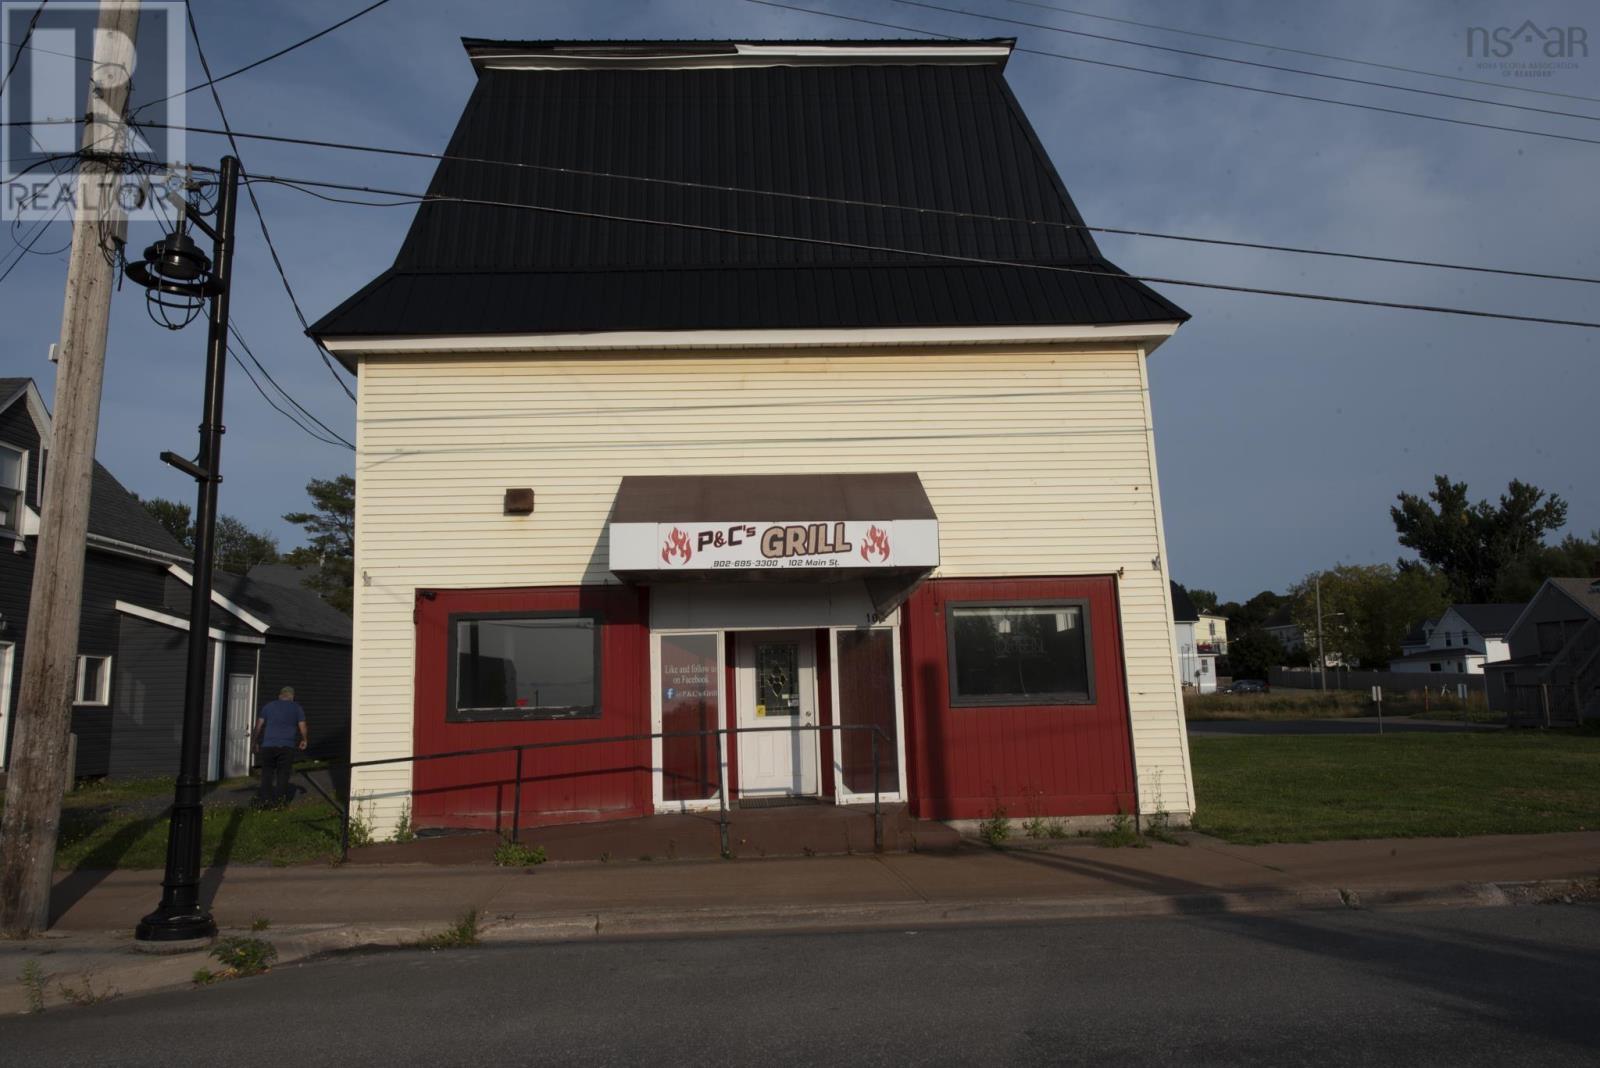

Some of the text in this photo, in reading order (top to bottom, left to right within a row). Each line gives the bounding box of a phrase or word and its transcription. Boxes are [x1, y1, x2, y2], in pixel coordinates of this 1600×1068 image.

[697, 522, 852, 559] P&C's GRILL
[713, 560, 778, 568] 902-695-3300
[788, 559, 803, 567] 102
[805, 559, 827, 567] Main
[665, 664, 678, 673] Like
[679, 664, 690, 673] and
[691, 663, 709, 673] follow
[681, 674, 708, 684] Facebook
